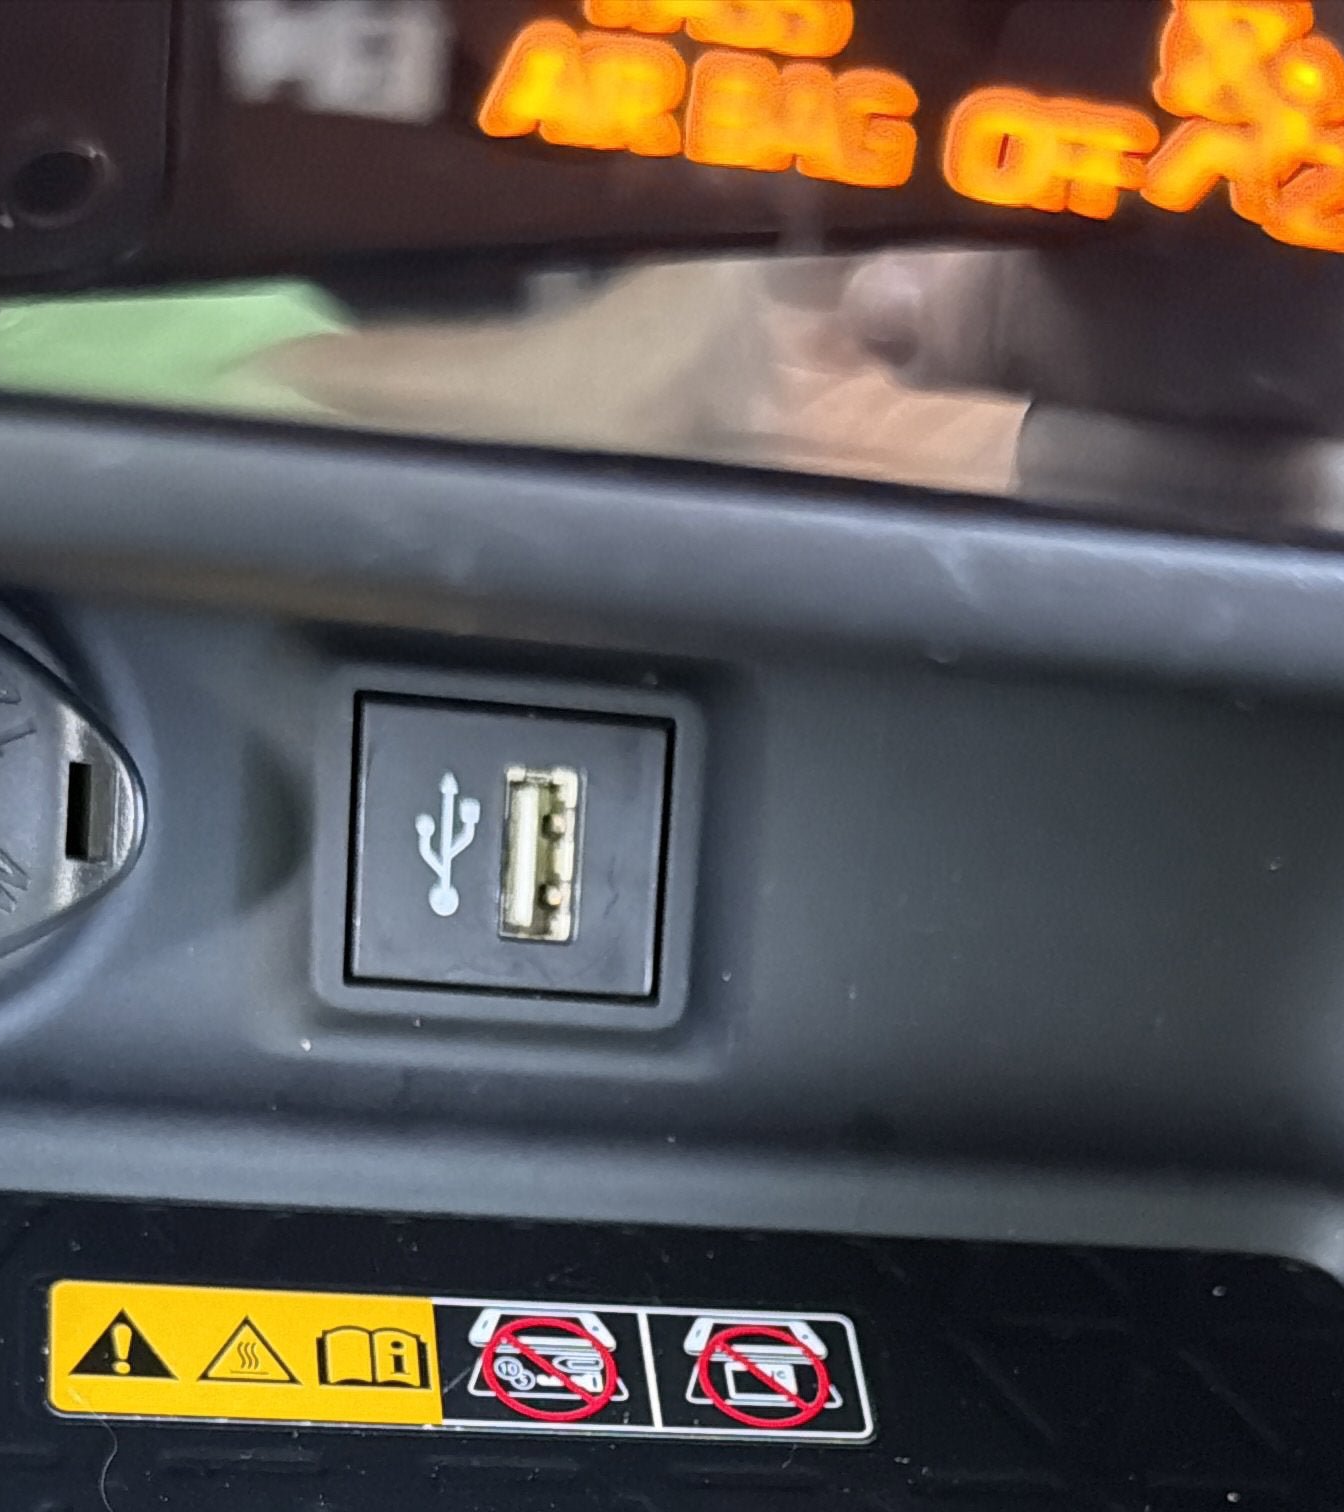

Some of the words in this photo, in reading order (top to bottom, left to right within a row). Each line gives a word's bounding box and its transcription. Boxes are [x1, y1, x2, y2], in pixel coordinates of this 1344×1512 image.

[478, 20, 686, 157] AIR
[684, 48, 919, 188] BAG
[943, 87, 1160, 220] OFF
